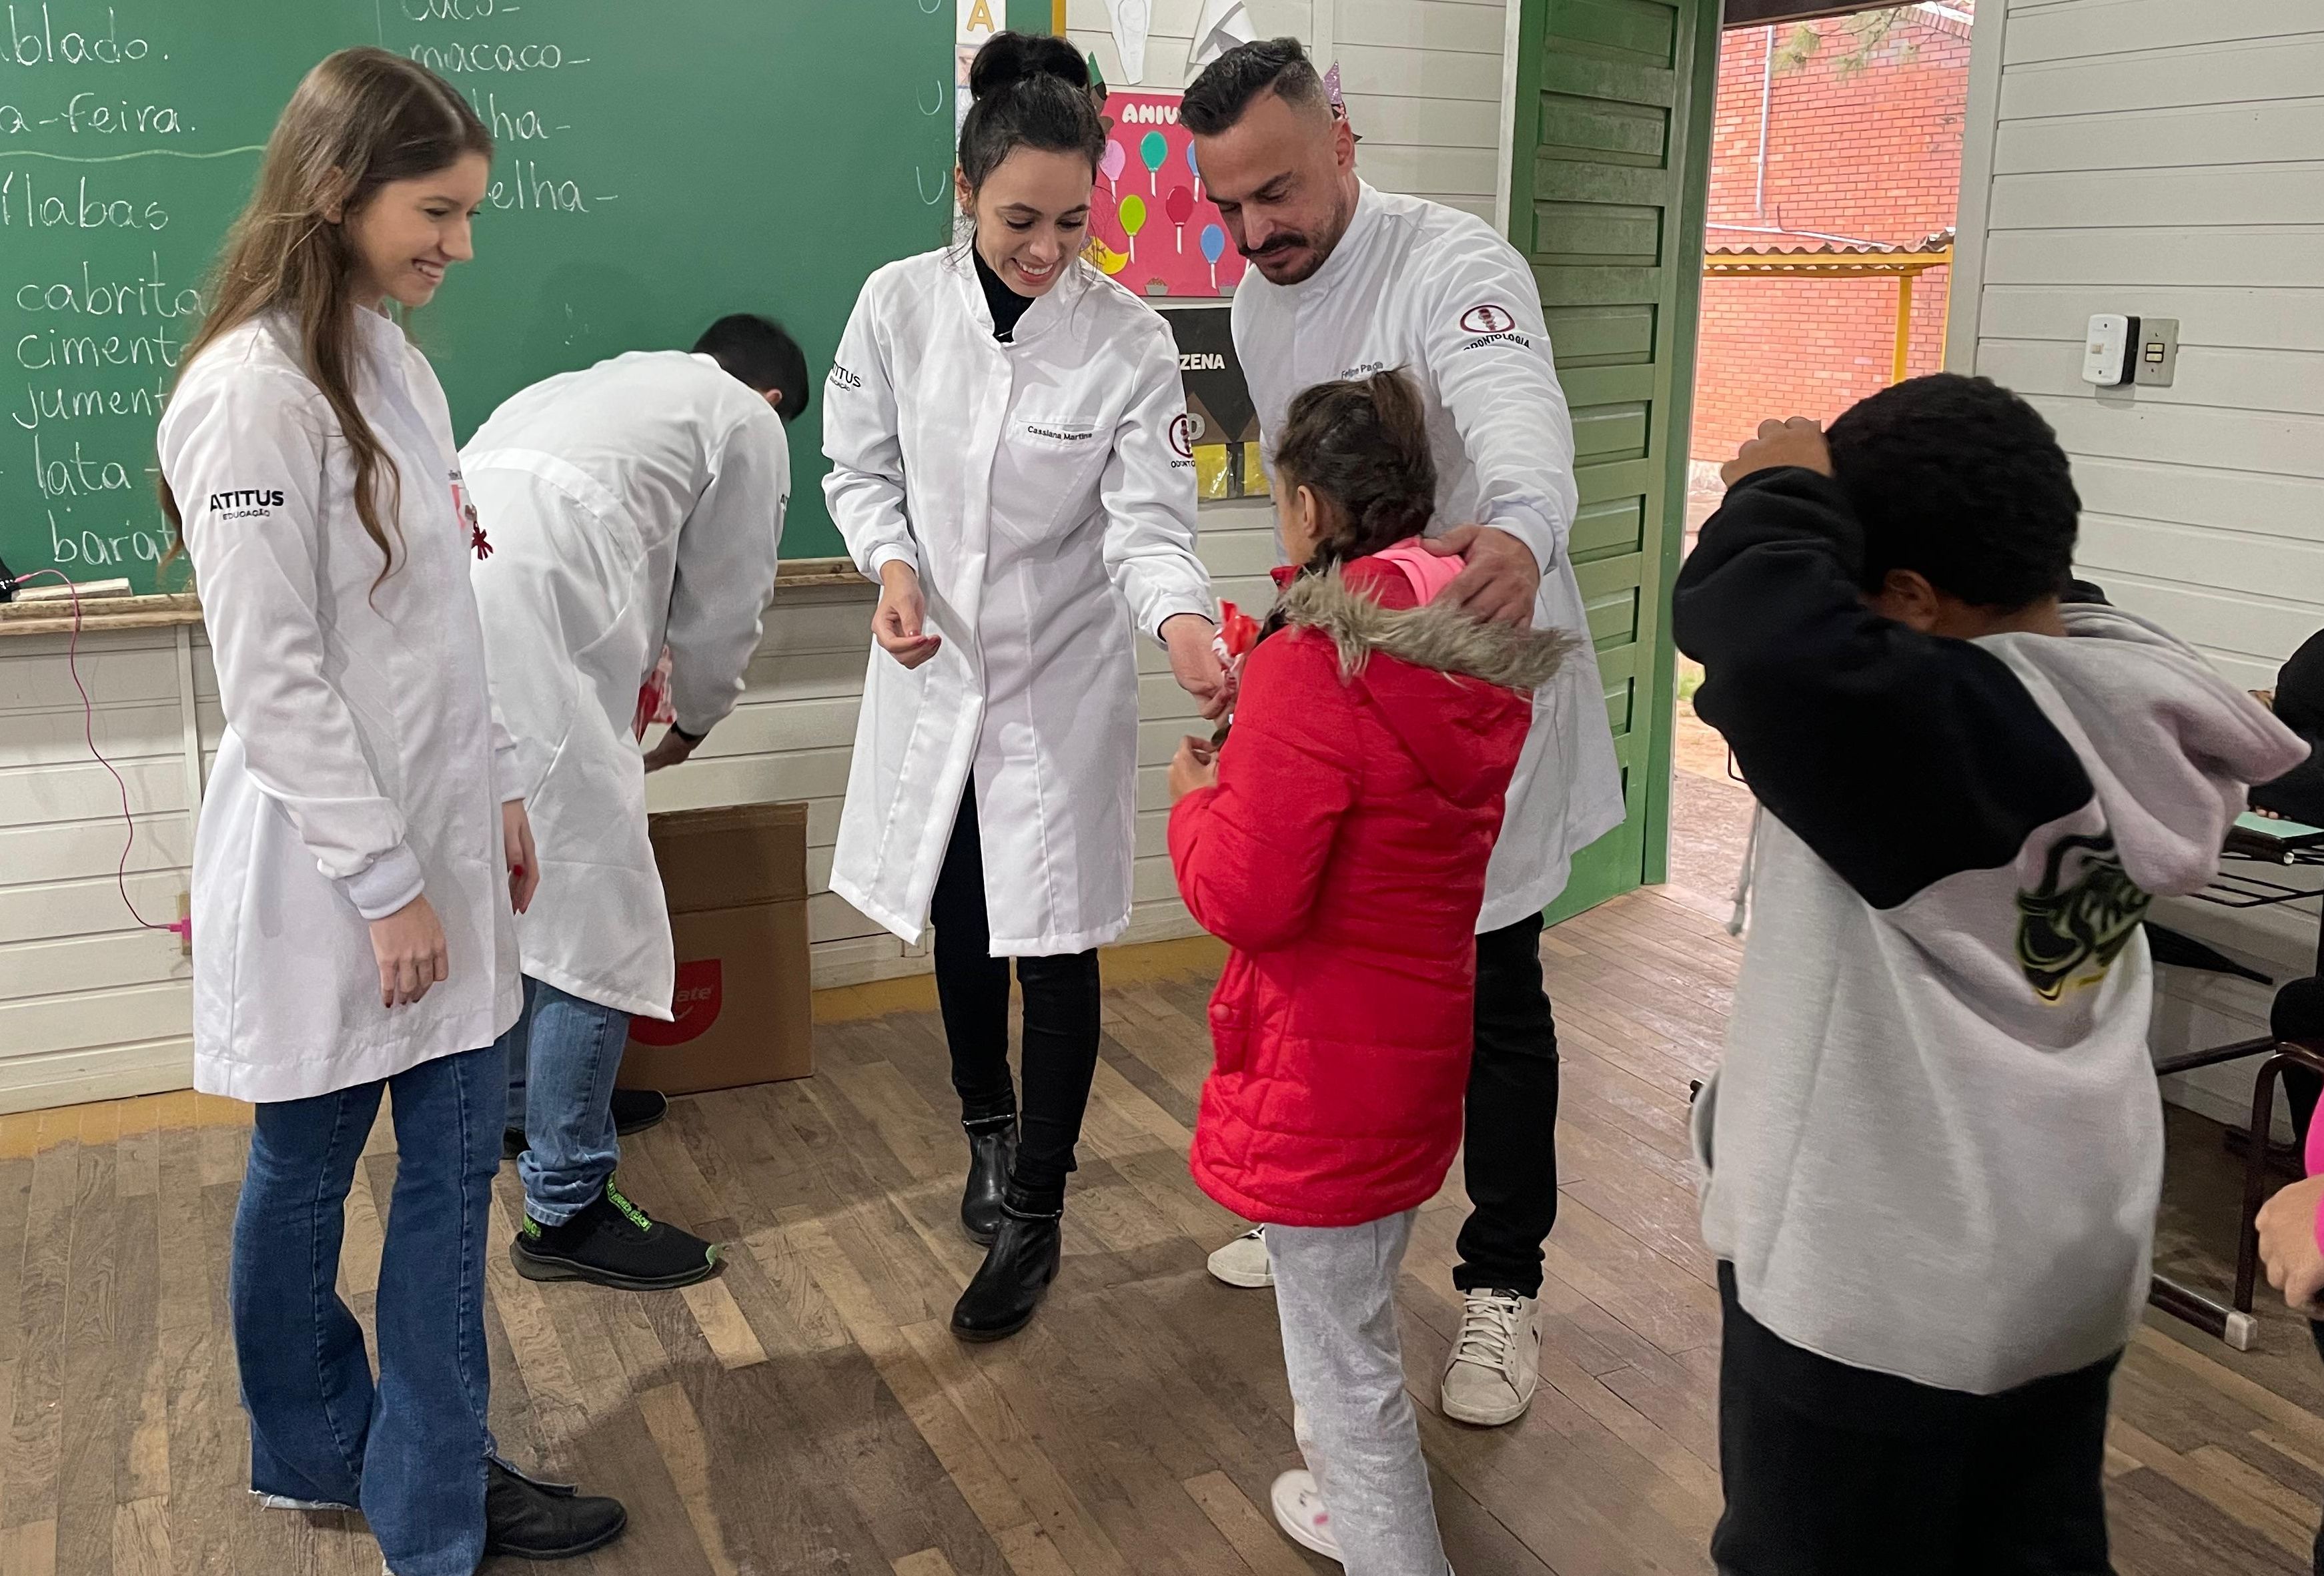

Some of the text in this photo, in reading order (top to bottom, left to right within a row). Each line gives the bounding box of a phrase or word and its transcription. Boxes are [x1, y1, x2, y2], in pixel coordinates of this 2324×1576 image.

[967, 0, 995, 32] A
[0, 2, 168, 65] blado.
[1121, 103, 1178, 125] ANIV
[1464, 334, 1532, 351] DONTOLOGIA
[1179, 354, 1225, 370] ZENA
[210, 489, 284, 512] ATITUS
[48, 508, 185, 566] barat
